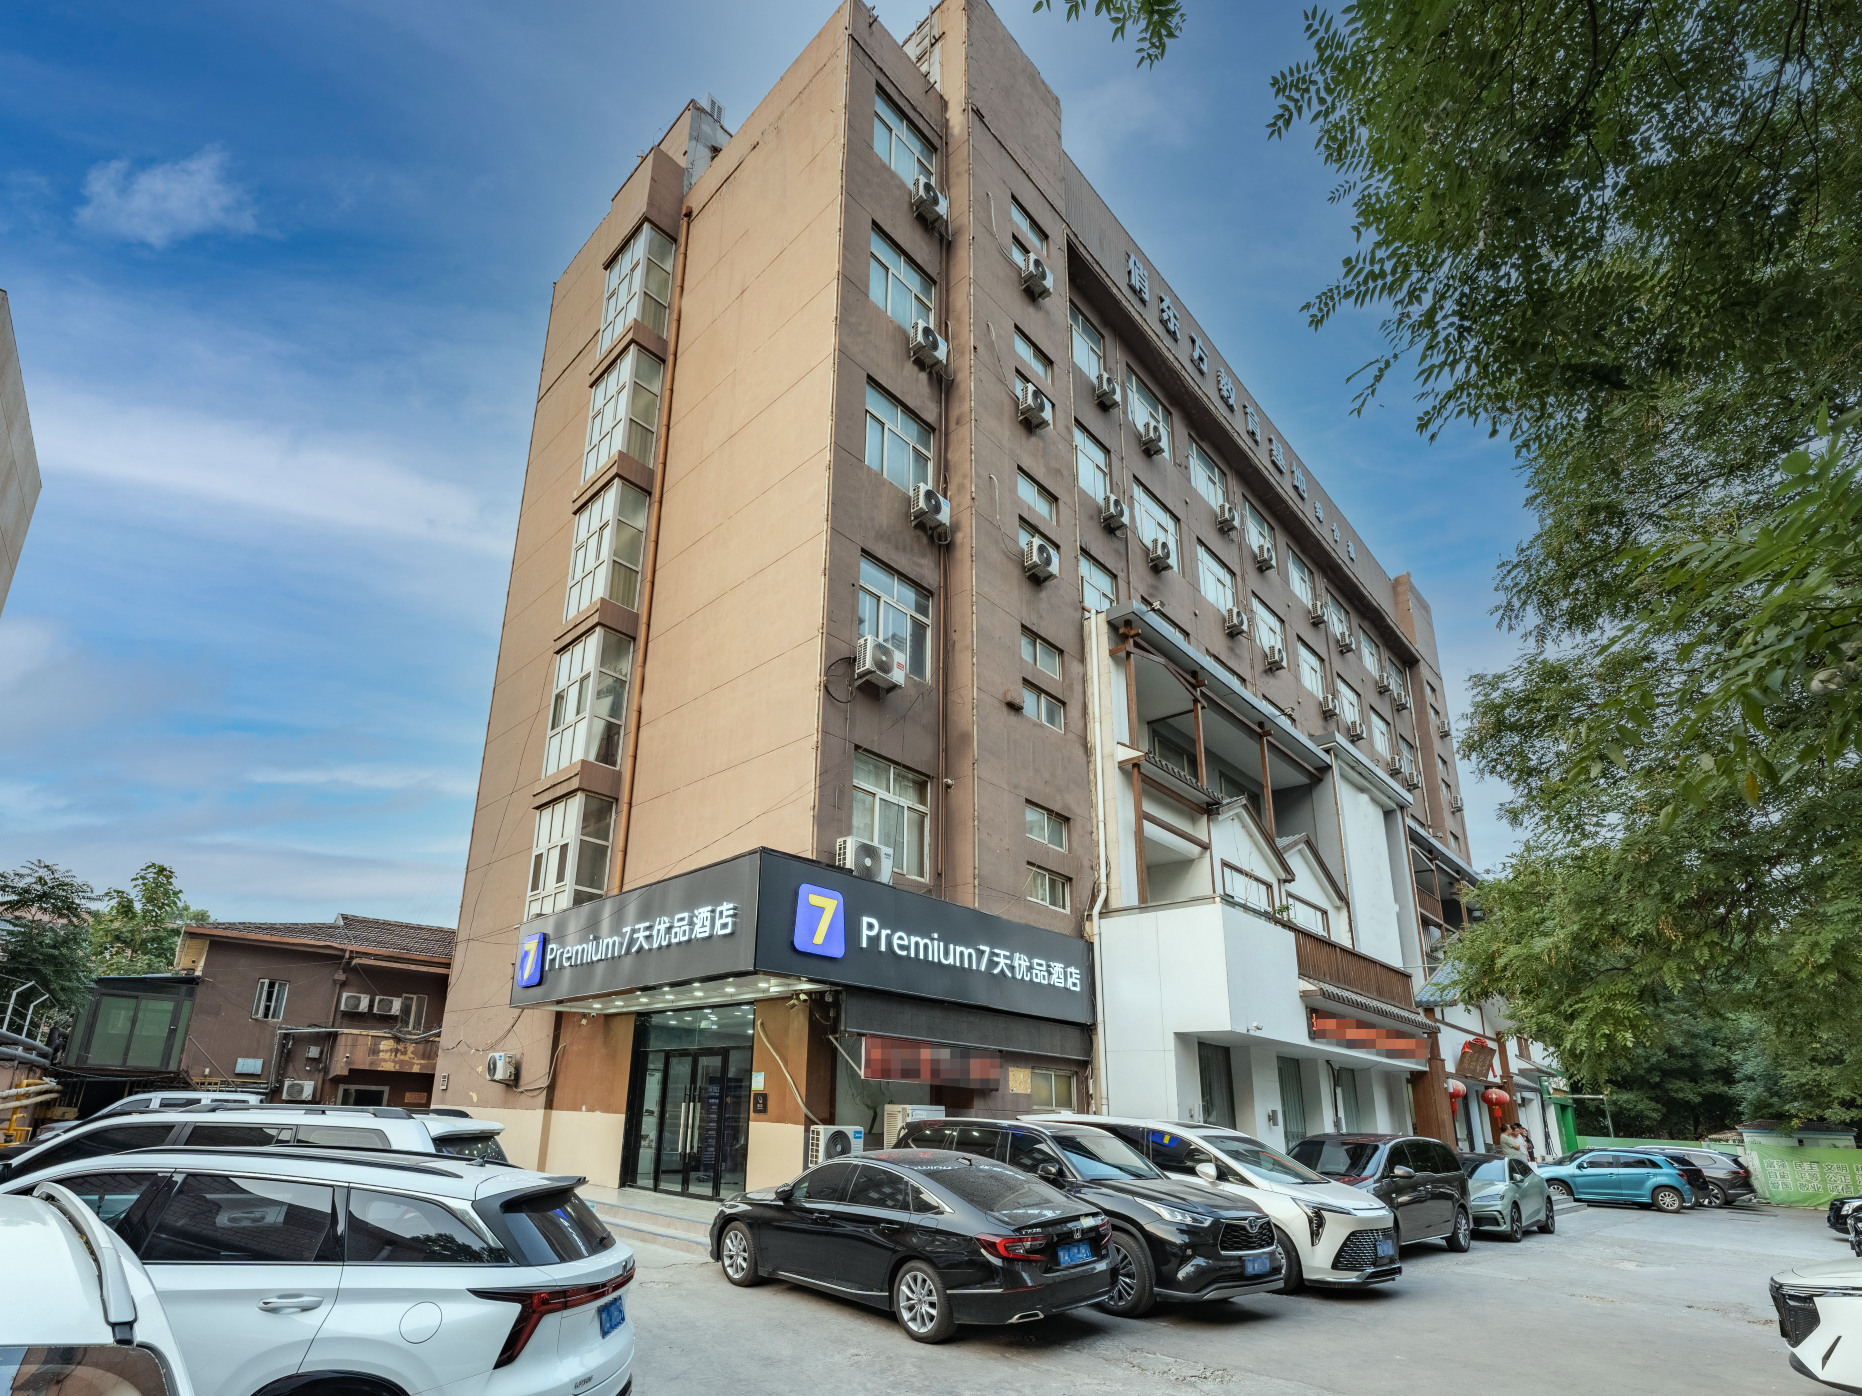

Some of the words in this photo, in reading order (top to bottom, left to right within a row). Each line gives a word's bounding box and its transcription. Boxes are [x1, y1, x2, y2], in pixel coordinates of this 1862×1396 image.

[524, 940, 538, 979] 7
[545, 902, 738, 970] Premium7天优品酒店
[808, 893, 838, 945] 7
[859, 916, 1080, 991] Premium7天优品酒店
[1764, 1160, 1788, 1170] 富强
[1793, 1161, 1819, 1171] 民主
[1823, 1163, 1849, 1173] 文明
[1767, 1171, 1790, 1180] 自由
[1796, 1172, 1820, 1182] 平等
[1826, 1174, 1851, 1185] 公正
[1769, 1181, 1793, 1191] 爱国
[1798, 1182, 1823, 1193] 敬业
[1828, 1184, 1854, 1195] 诚信
